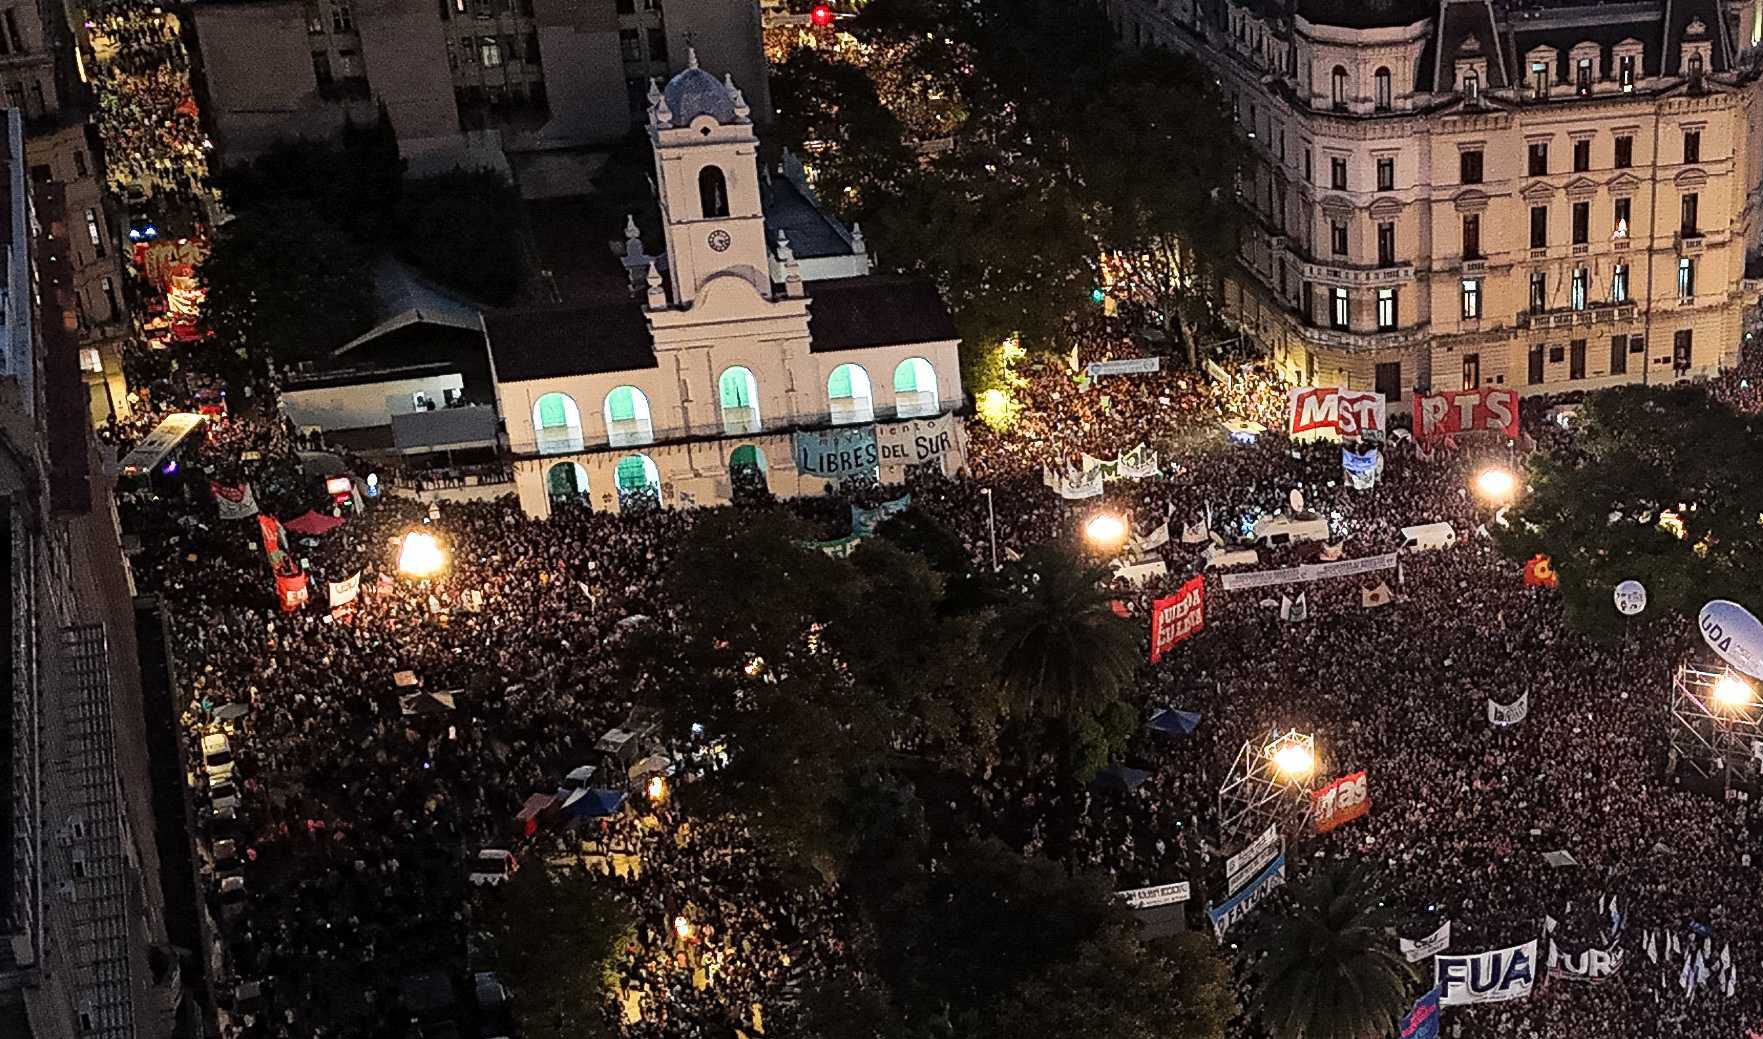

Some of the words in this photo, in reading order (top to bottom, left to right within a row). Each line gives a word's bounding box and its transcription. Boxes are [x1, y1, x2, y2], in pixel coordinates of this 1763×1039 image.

[1300, 393, 1377, 434] MST
[803, 443, 877, 473] LIBRES
[881, 444, 909, 459] DEL
[915, 431, 951, 461] SUR
[1701, 614, 1733, 653] UDA
[1437, 949, 1532, 998] FUA
